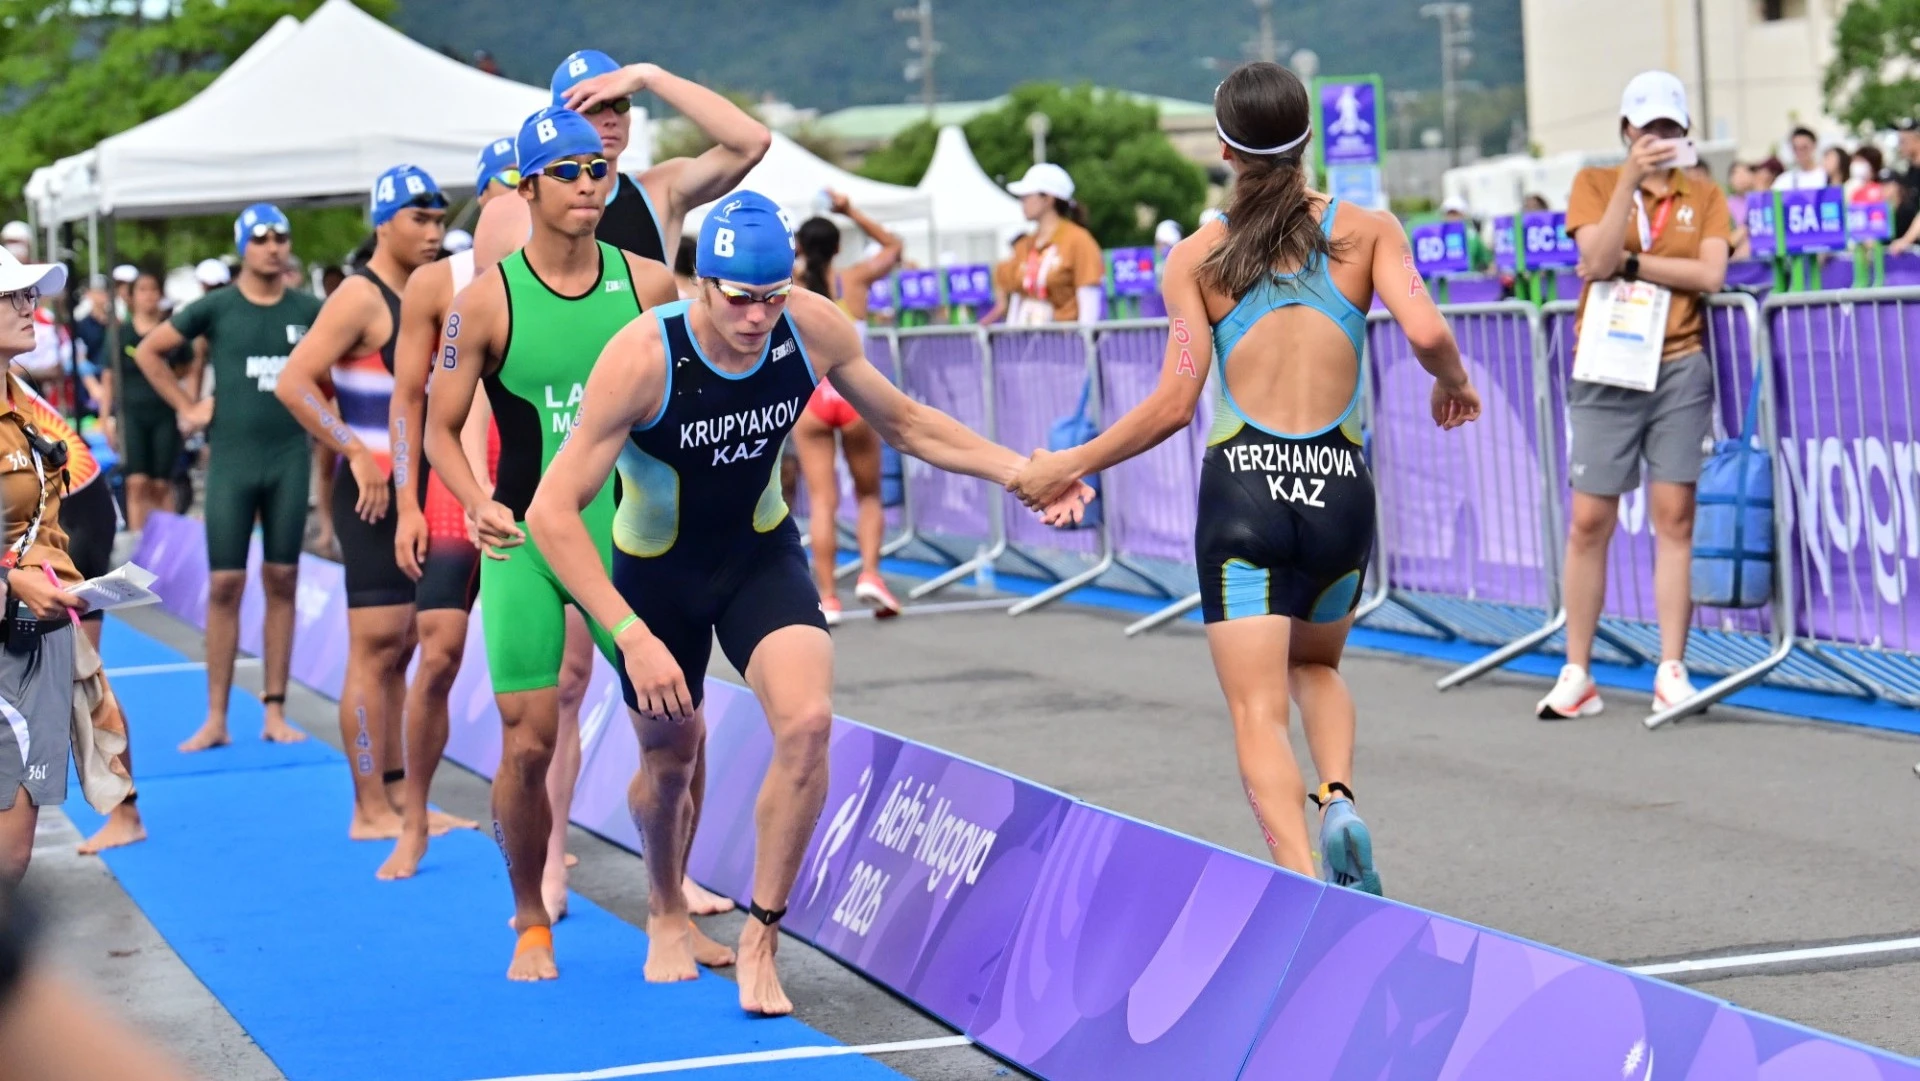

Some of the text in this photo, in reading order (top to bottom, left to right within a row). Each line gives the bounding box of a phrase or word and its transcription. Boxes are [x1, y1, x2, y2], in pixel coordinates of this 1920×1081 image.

[569, 58, 589, 78] B
[536, 118, 558, 144] B
[1789, 204, 1820, 233] 5A
[714, 227, 735, 258] B
[680, 397, 799, 449] KRUPYAKOV
[711, 438, 768, 467] KAZ
[1223, 443, 1357, 478] YERZHANOVA
[1266, 474, 1326, 508] KAZ
[869, 776, 997, 900] Aichi-Nagoya
[832, 860, 890, 937] 2026
